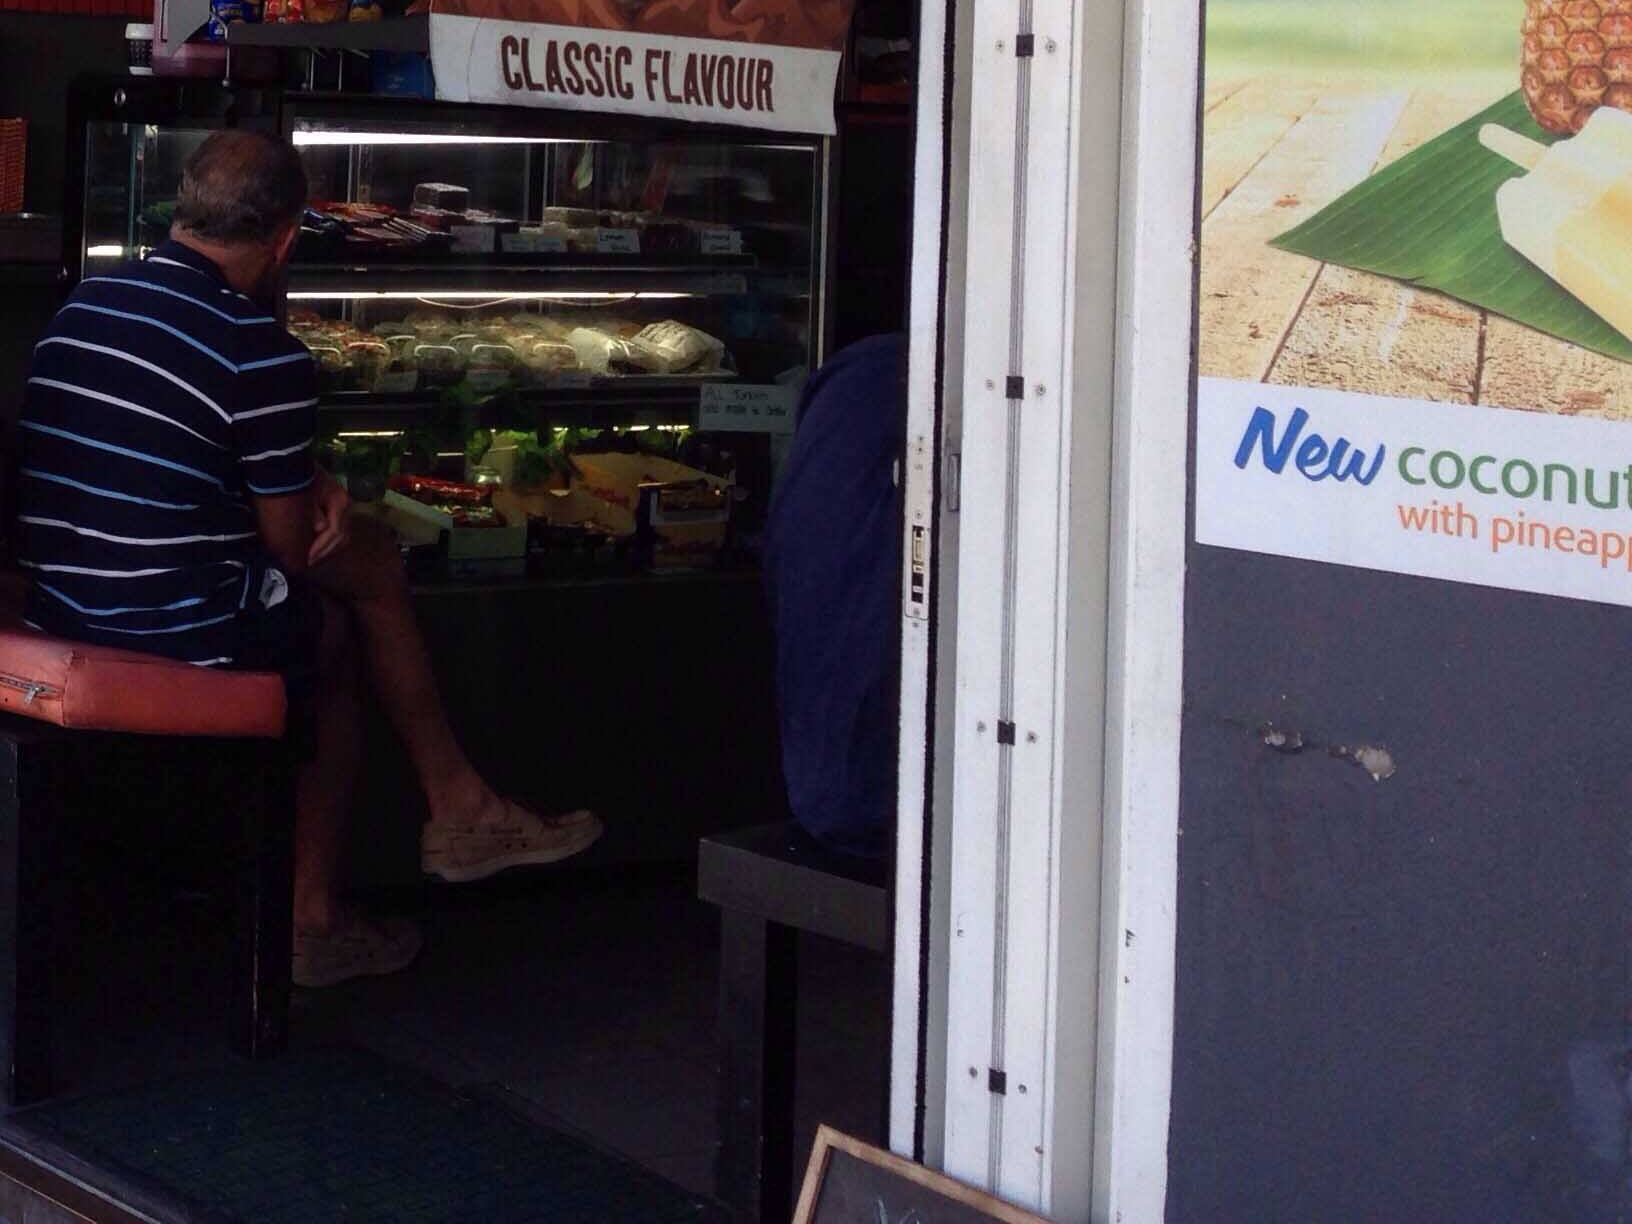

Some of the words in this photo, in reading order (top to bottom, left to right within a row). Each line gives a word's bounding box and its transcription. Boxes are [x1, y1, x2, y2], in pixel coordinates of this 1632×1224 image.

[645, 47, 775, 113] FLAVOUR
[1233, 405, 1386, 486] New
[1397, 498, 1479, 539] with
[1490, 511, 1632, 572] pineap
